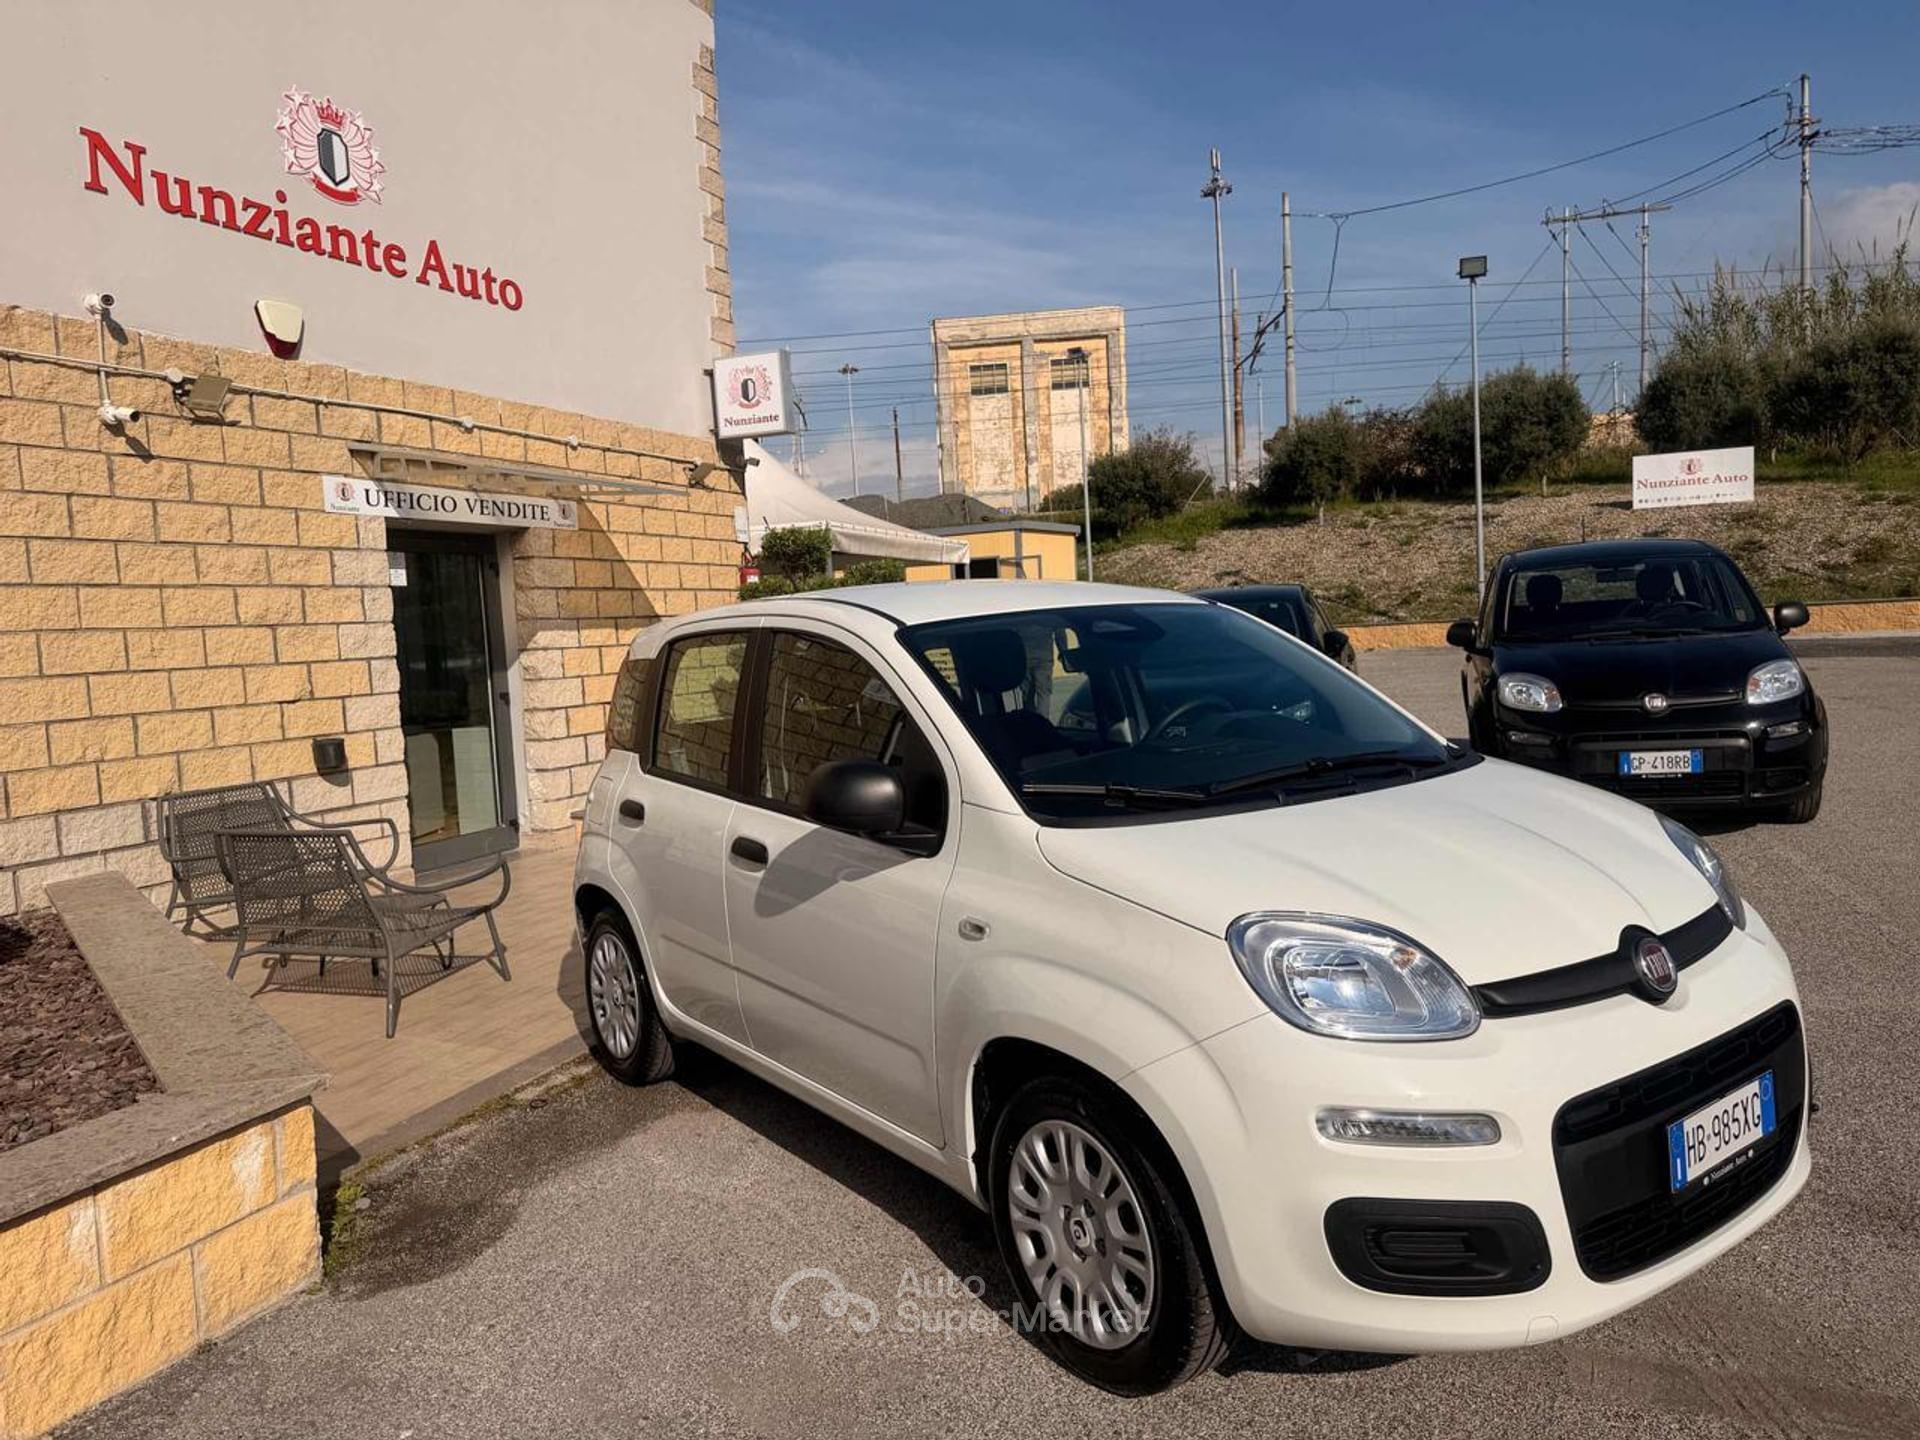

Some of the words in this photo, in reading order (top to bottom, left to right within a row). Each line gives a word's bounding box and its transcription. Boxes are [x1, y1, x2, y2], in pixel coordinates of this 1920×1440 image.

[79, 126, 408, 278] Nunziante
[415, 239, 524, 311] Auto
[724, 413, 780, 427] Nunziante
[1636, 475, 1710, 490] Nunziante
[1711, 473, 1749, 484] Auto
[364, 488, 457, 513] UFFICIO
[464, 497, 551, 522] VENDITE
